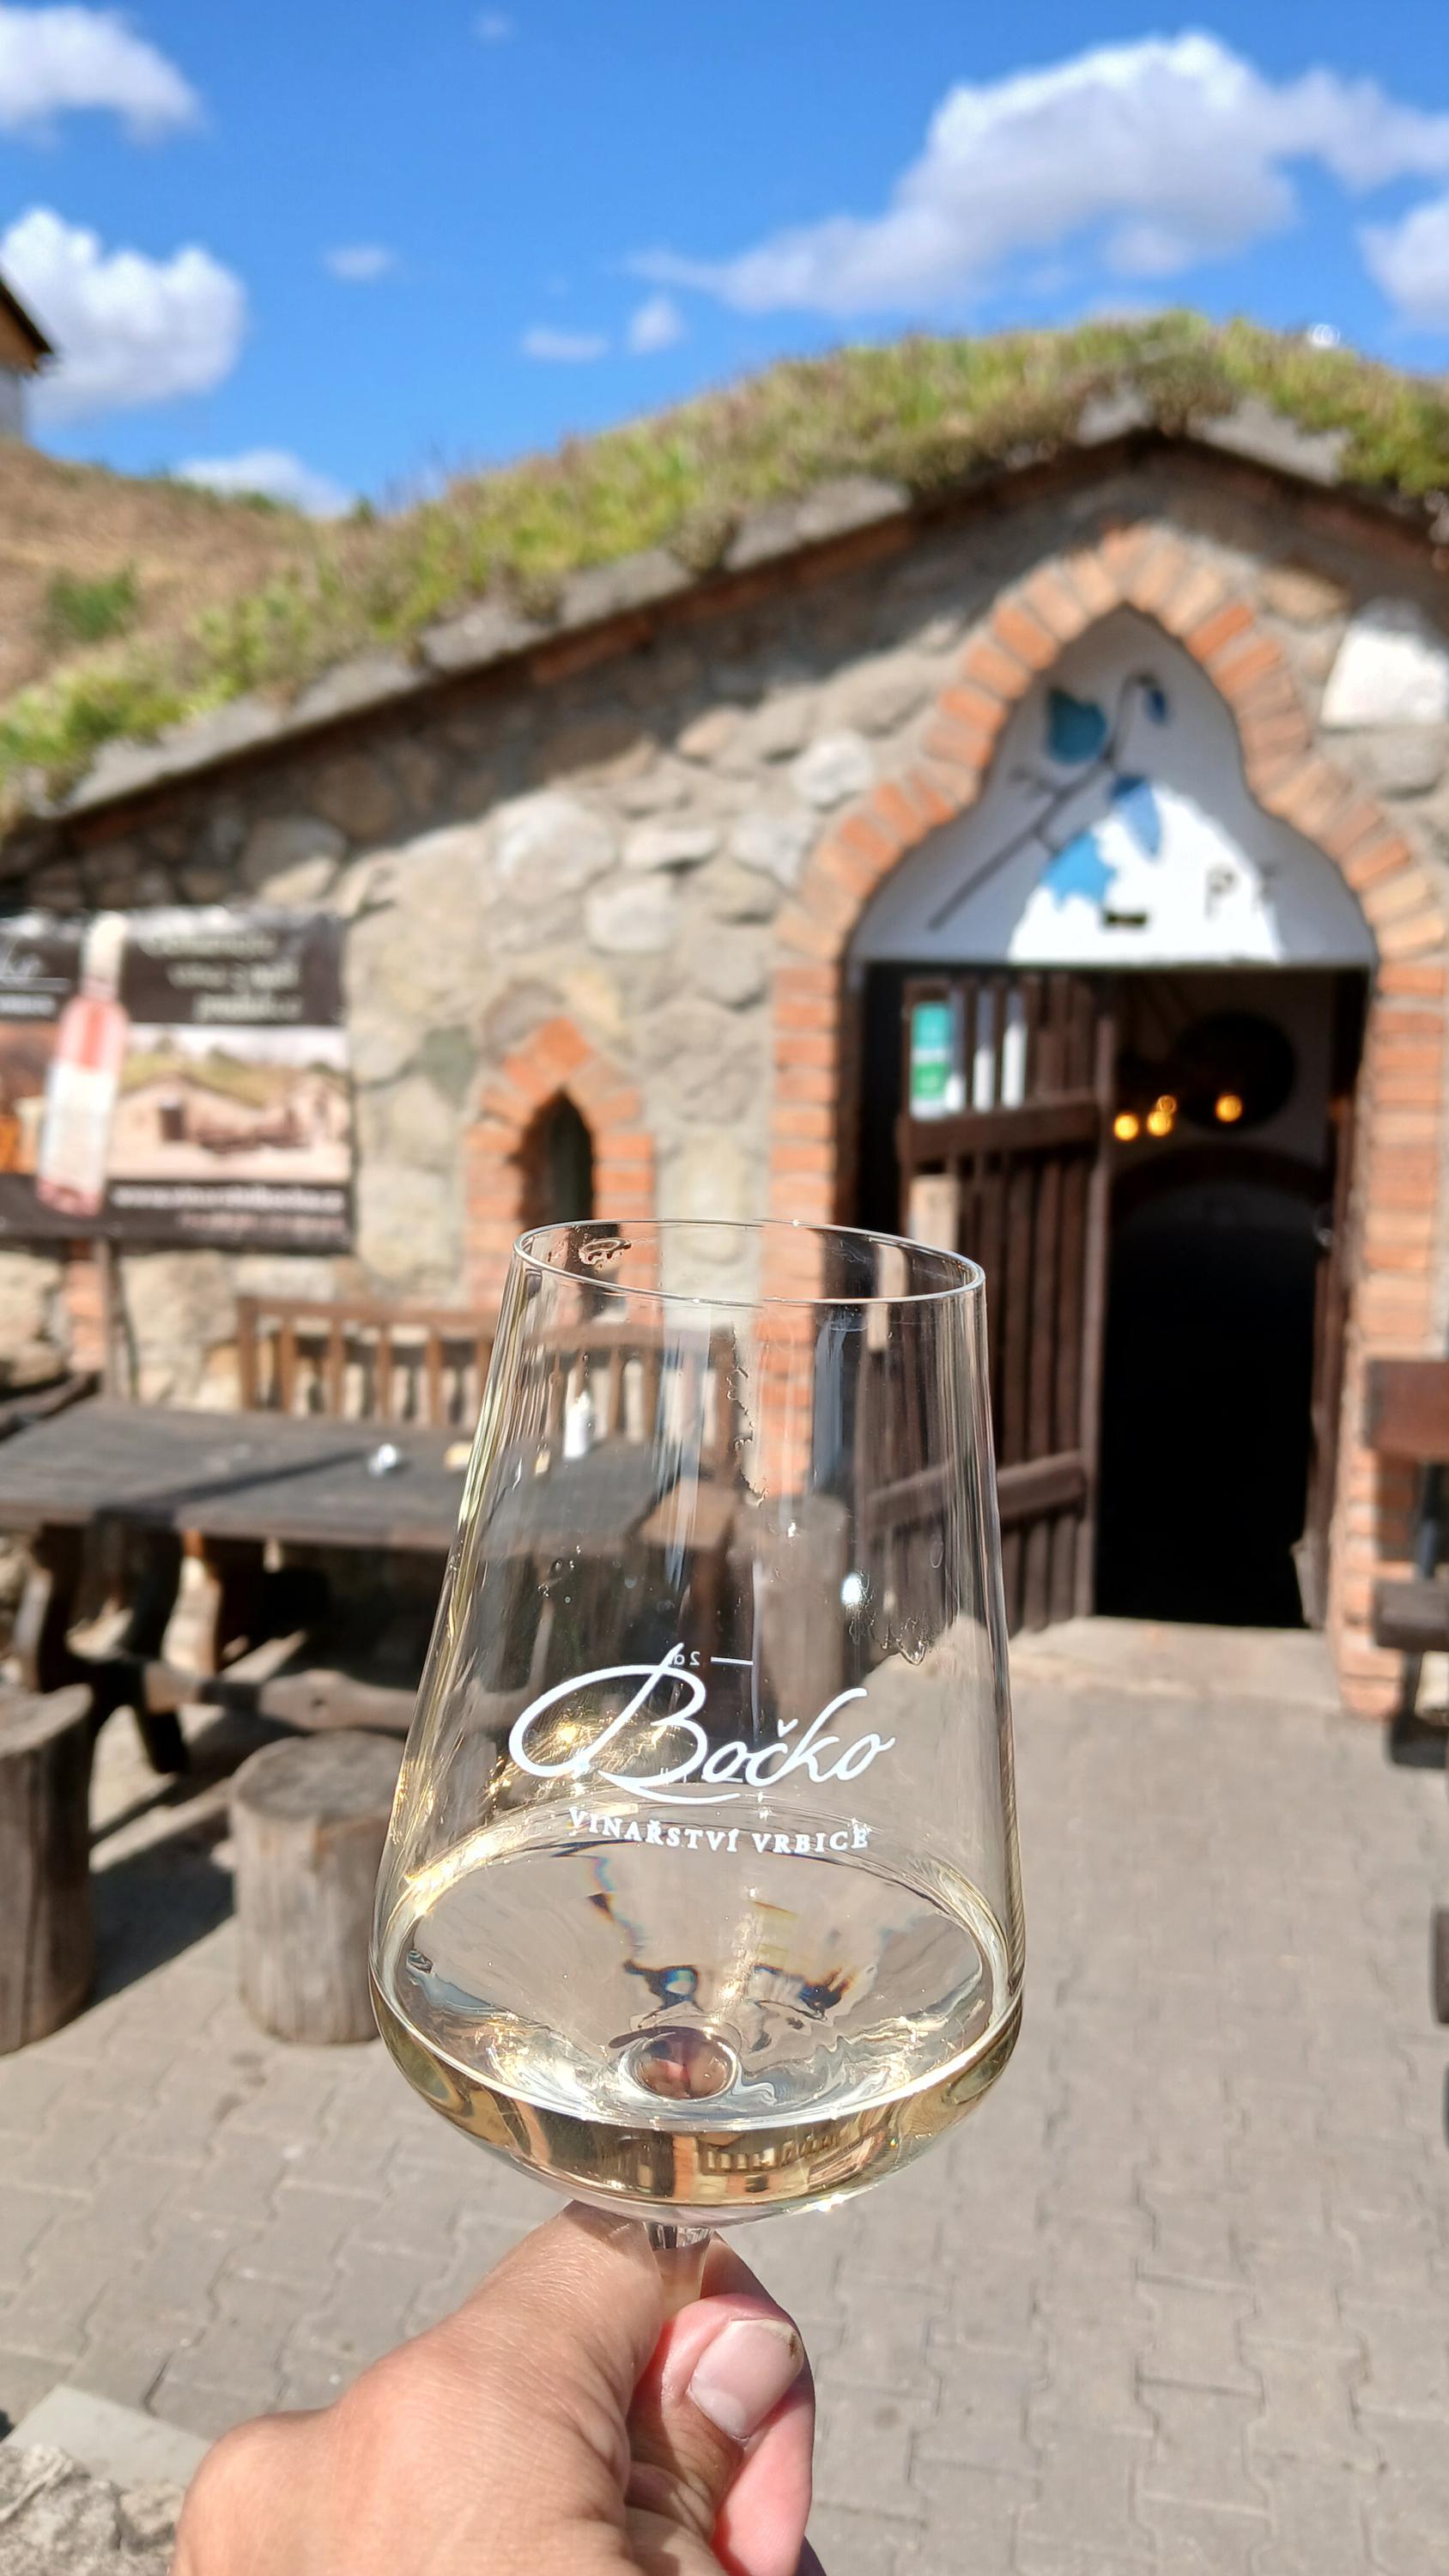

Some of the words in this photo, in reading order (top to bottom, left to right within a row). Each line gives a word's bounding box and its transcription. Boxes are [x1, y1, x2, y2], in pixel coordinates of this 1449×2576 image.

[508, 1643, 896, 1804] Bočko
[568, 1807, 739, 1852] VINAŘSTVÍ
[751, 1823, 870, 1853] VRBICE
